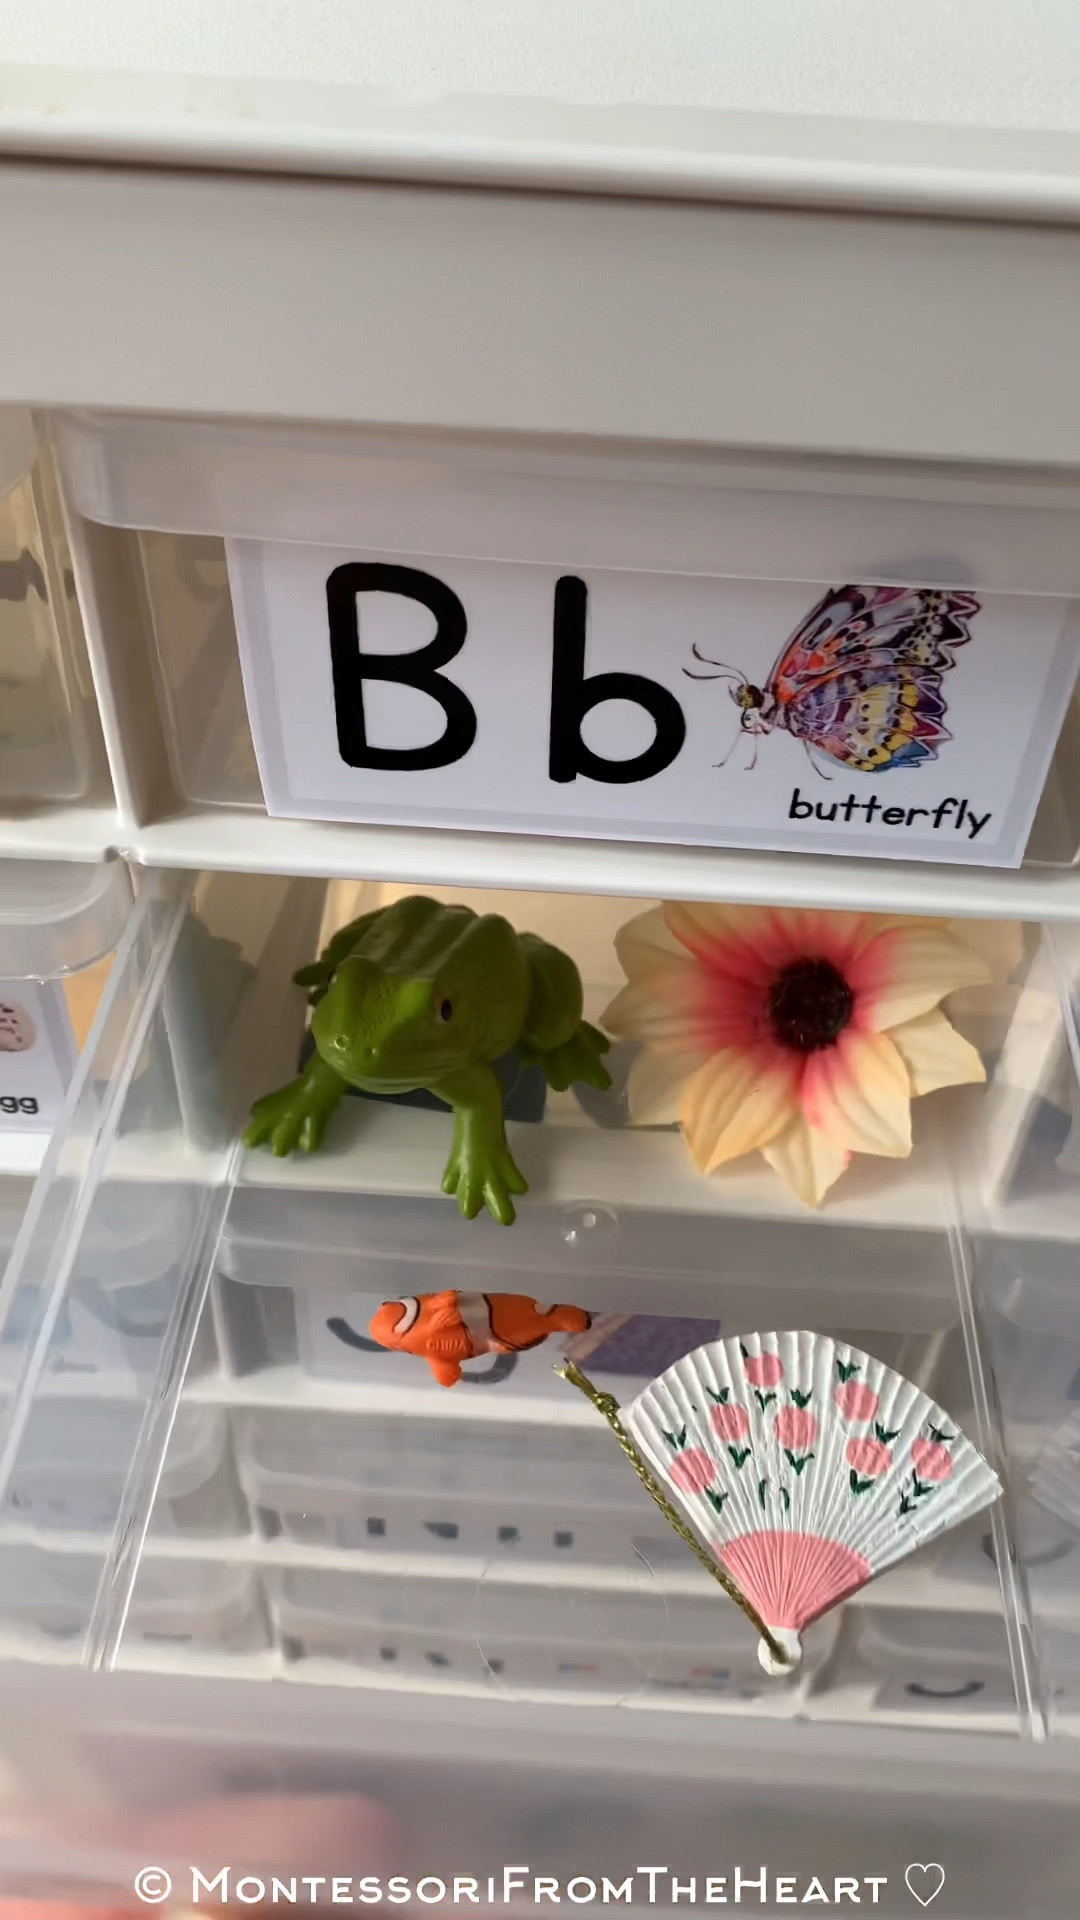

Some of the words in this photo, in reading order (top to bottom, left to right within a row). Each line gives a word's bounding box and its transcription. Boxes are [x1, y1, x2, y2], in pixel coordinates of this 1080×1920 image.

[326, 562, 477, 772] B
[549, 575, 686, 784] b
[788, 787, 993, 840] butterfly
[425, 1338, 467, 1353] CHINA
